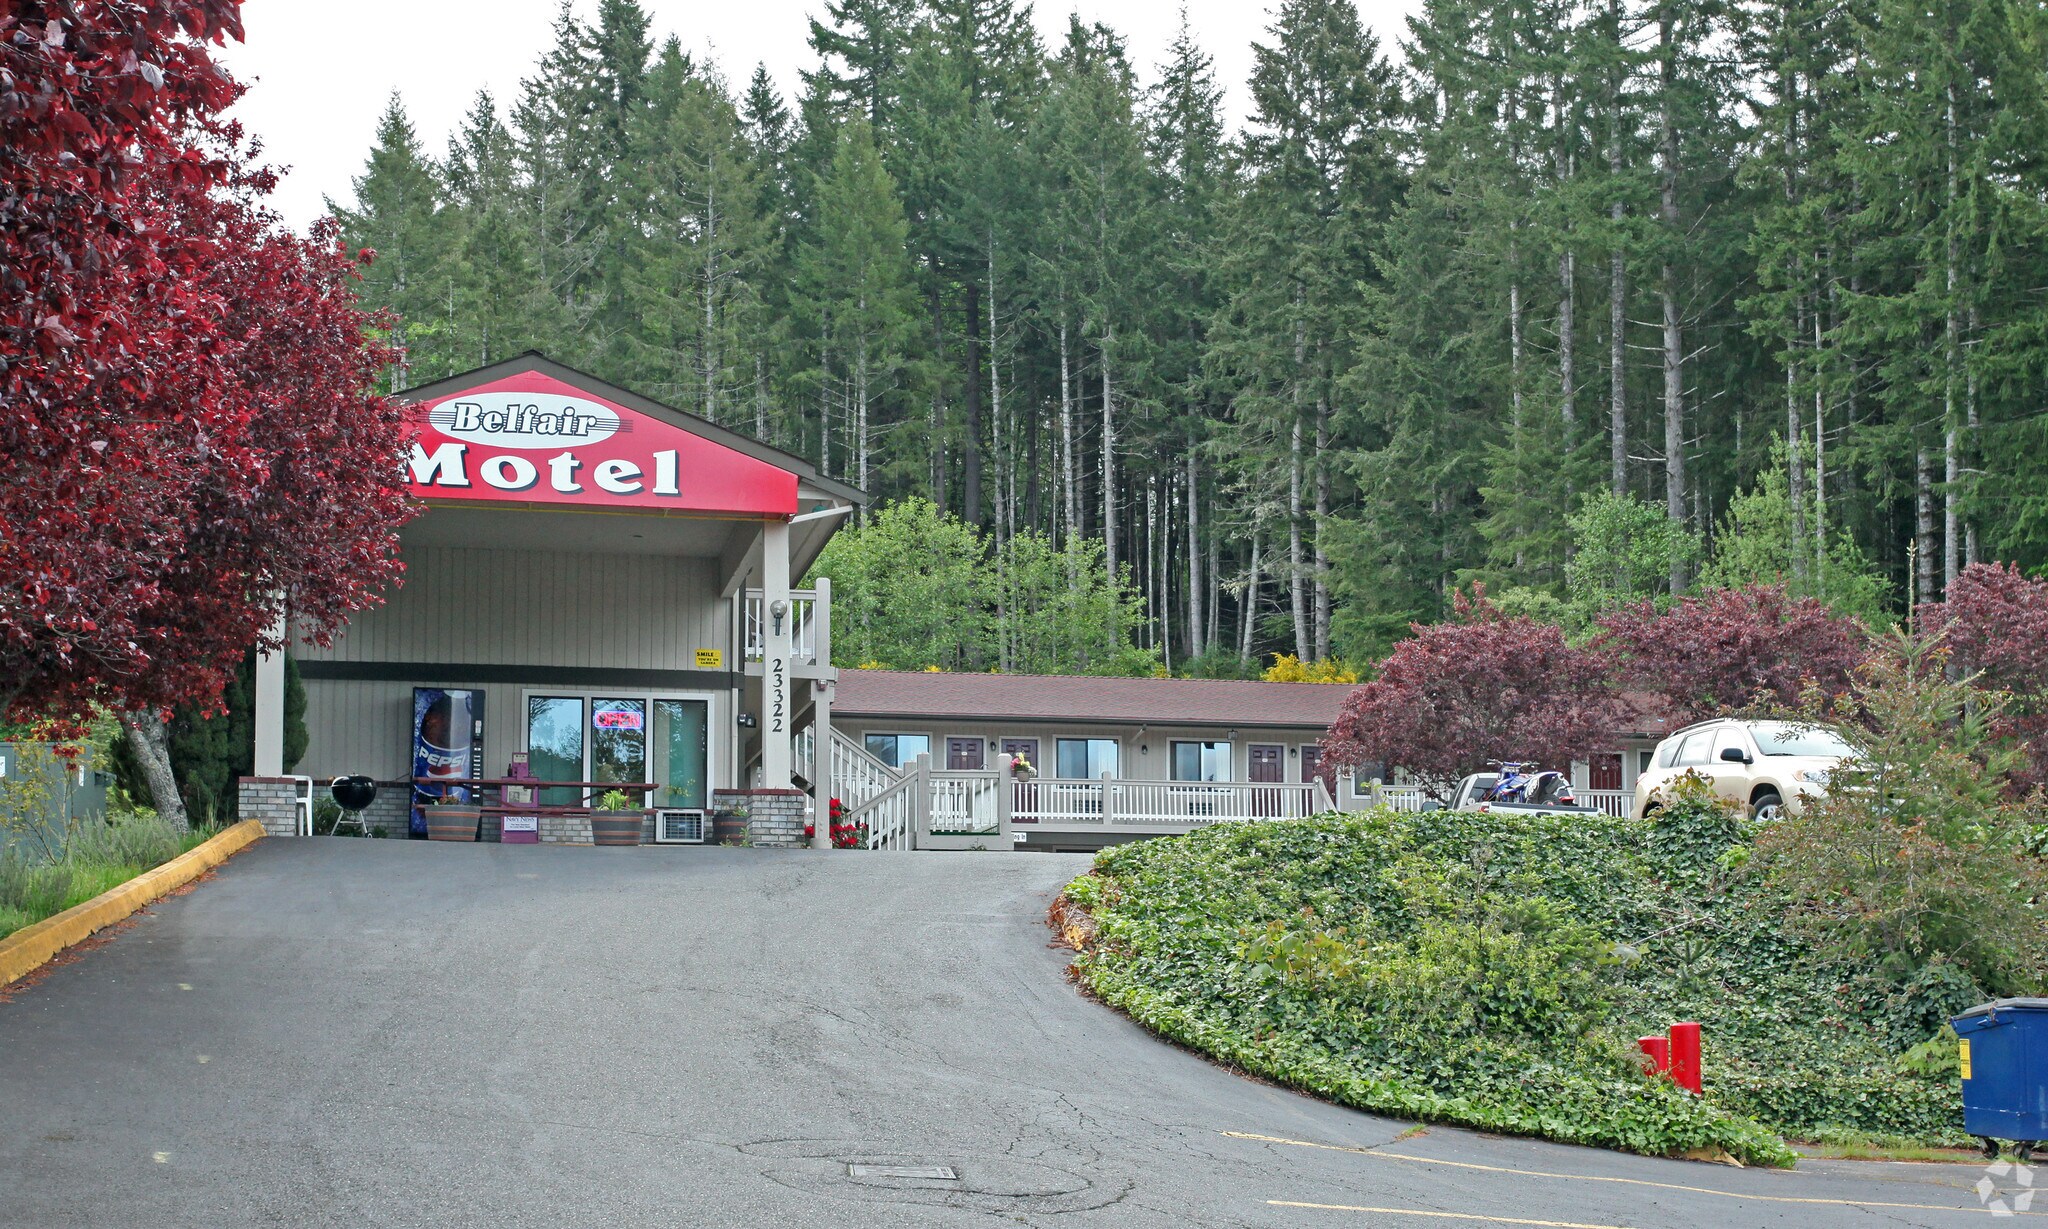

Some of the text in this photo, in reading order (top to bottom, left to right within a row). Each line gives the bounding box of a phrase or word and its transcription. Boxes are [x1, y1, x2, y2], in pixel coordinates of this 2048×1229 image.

[451, 402, 597, 437] Belfair
[402, 442, 682, 497] Motel
[772, 658, 783, 732] 23322
[597, 711, 640, 728] OPEN
[418, 746, 466, 767] PEPSI
